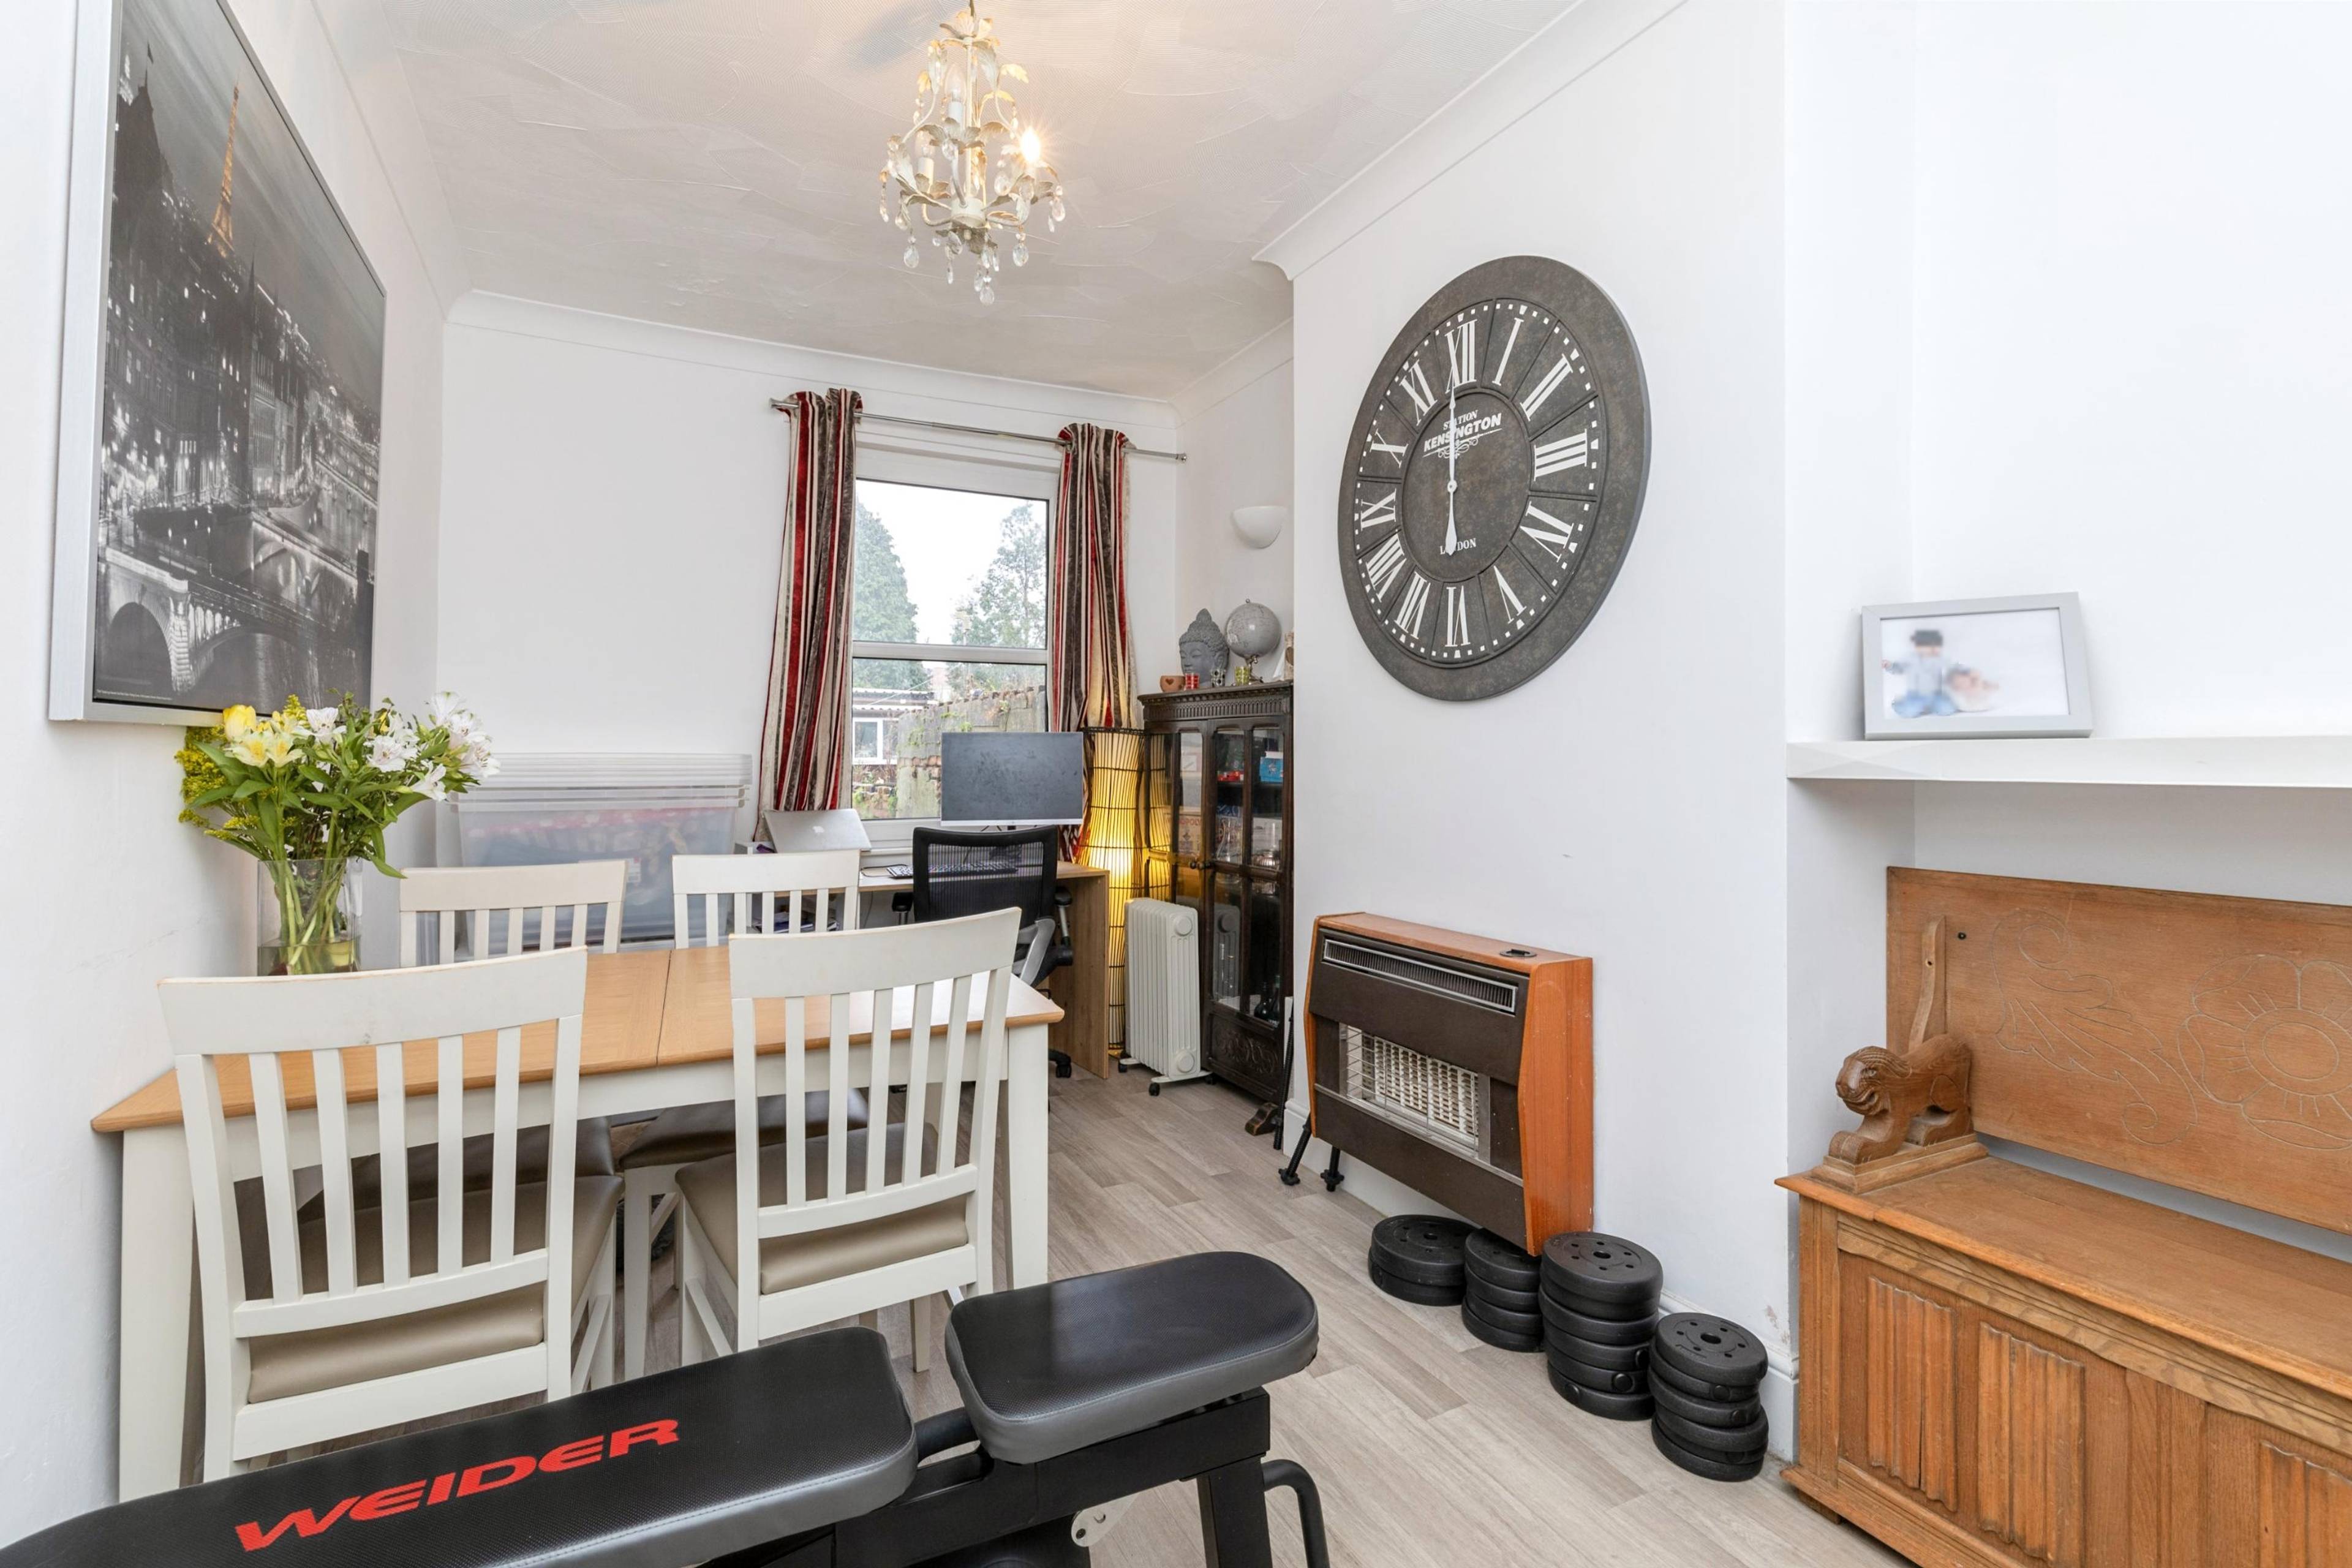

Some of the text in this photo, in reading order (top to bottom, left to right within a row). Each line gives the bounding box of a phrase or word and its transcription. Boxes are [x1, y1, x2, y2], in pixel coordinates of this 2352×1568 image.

[1445, 319, 1477, 394] XII
[1520, 353, 1574, 421] II
[1399, 359, 1438, 426] XI
[1370, 429, 1409, 468] X
[1424, 413, 1502, 452] KENSNGTON
[1533, 429, 1588, 481] III
[1360, 488, 1396, 531] IX
[1519, 501, 1574, 562] IV
[1439, 538, 1477, 555] LDON
[1393, 571, 1431, 639] VII
[1445, 585, 1471, 647] VI
[1494, 565, 1527, 624] V
[235, 1419, 679, 1551] WEIDER
